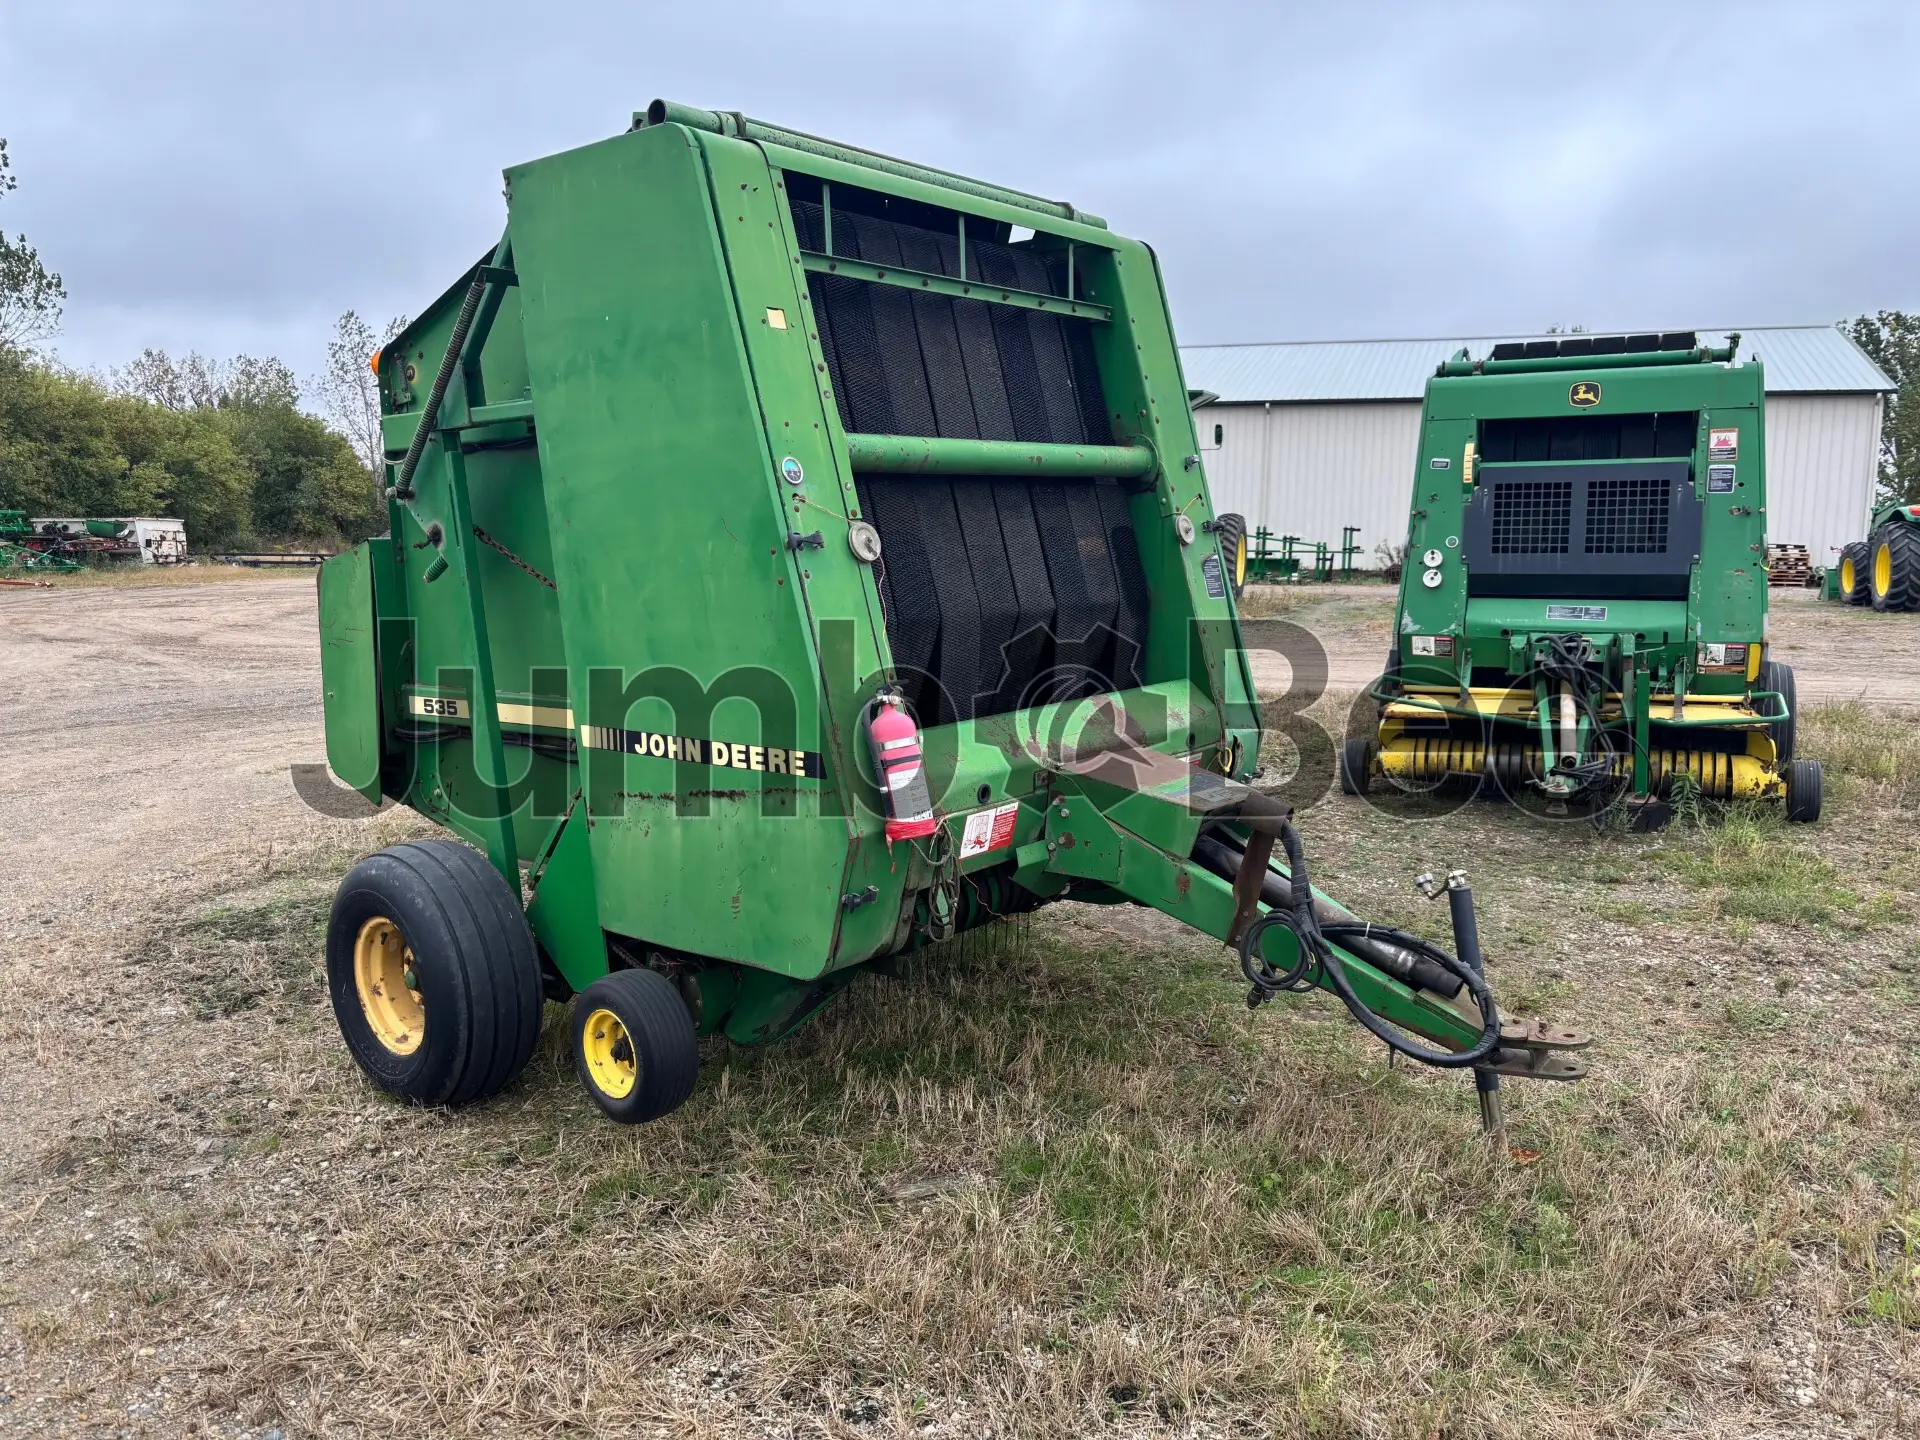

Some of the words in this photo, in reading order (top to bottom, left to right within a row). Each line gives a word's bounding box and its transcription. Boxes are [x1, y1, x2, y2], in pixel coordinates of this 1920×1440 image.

[423, 698, 458, 716] 535
[634, 732, 702, 763] JOHN
[711, 741, 806, 777] DEERE
